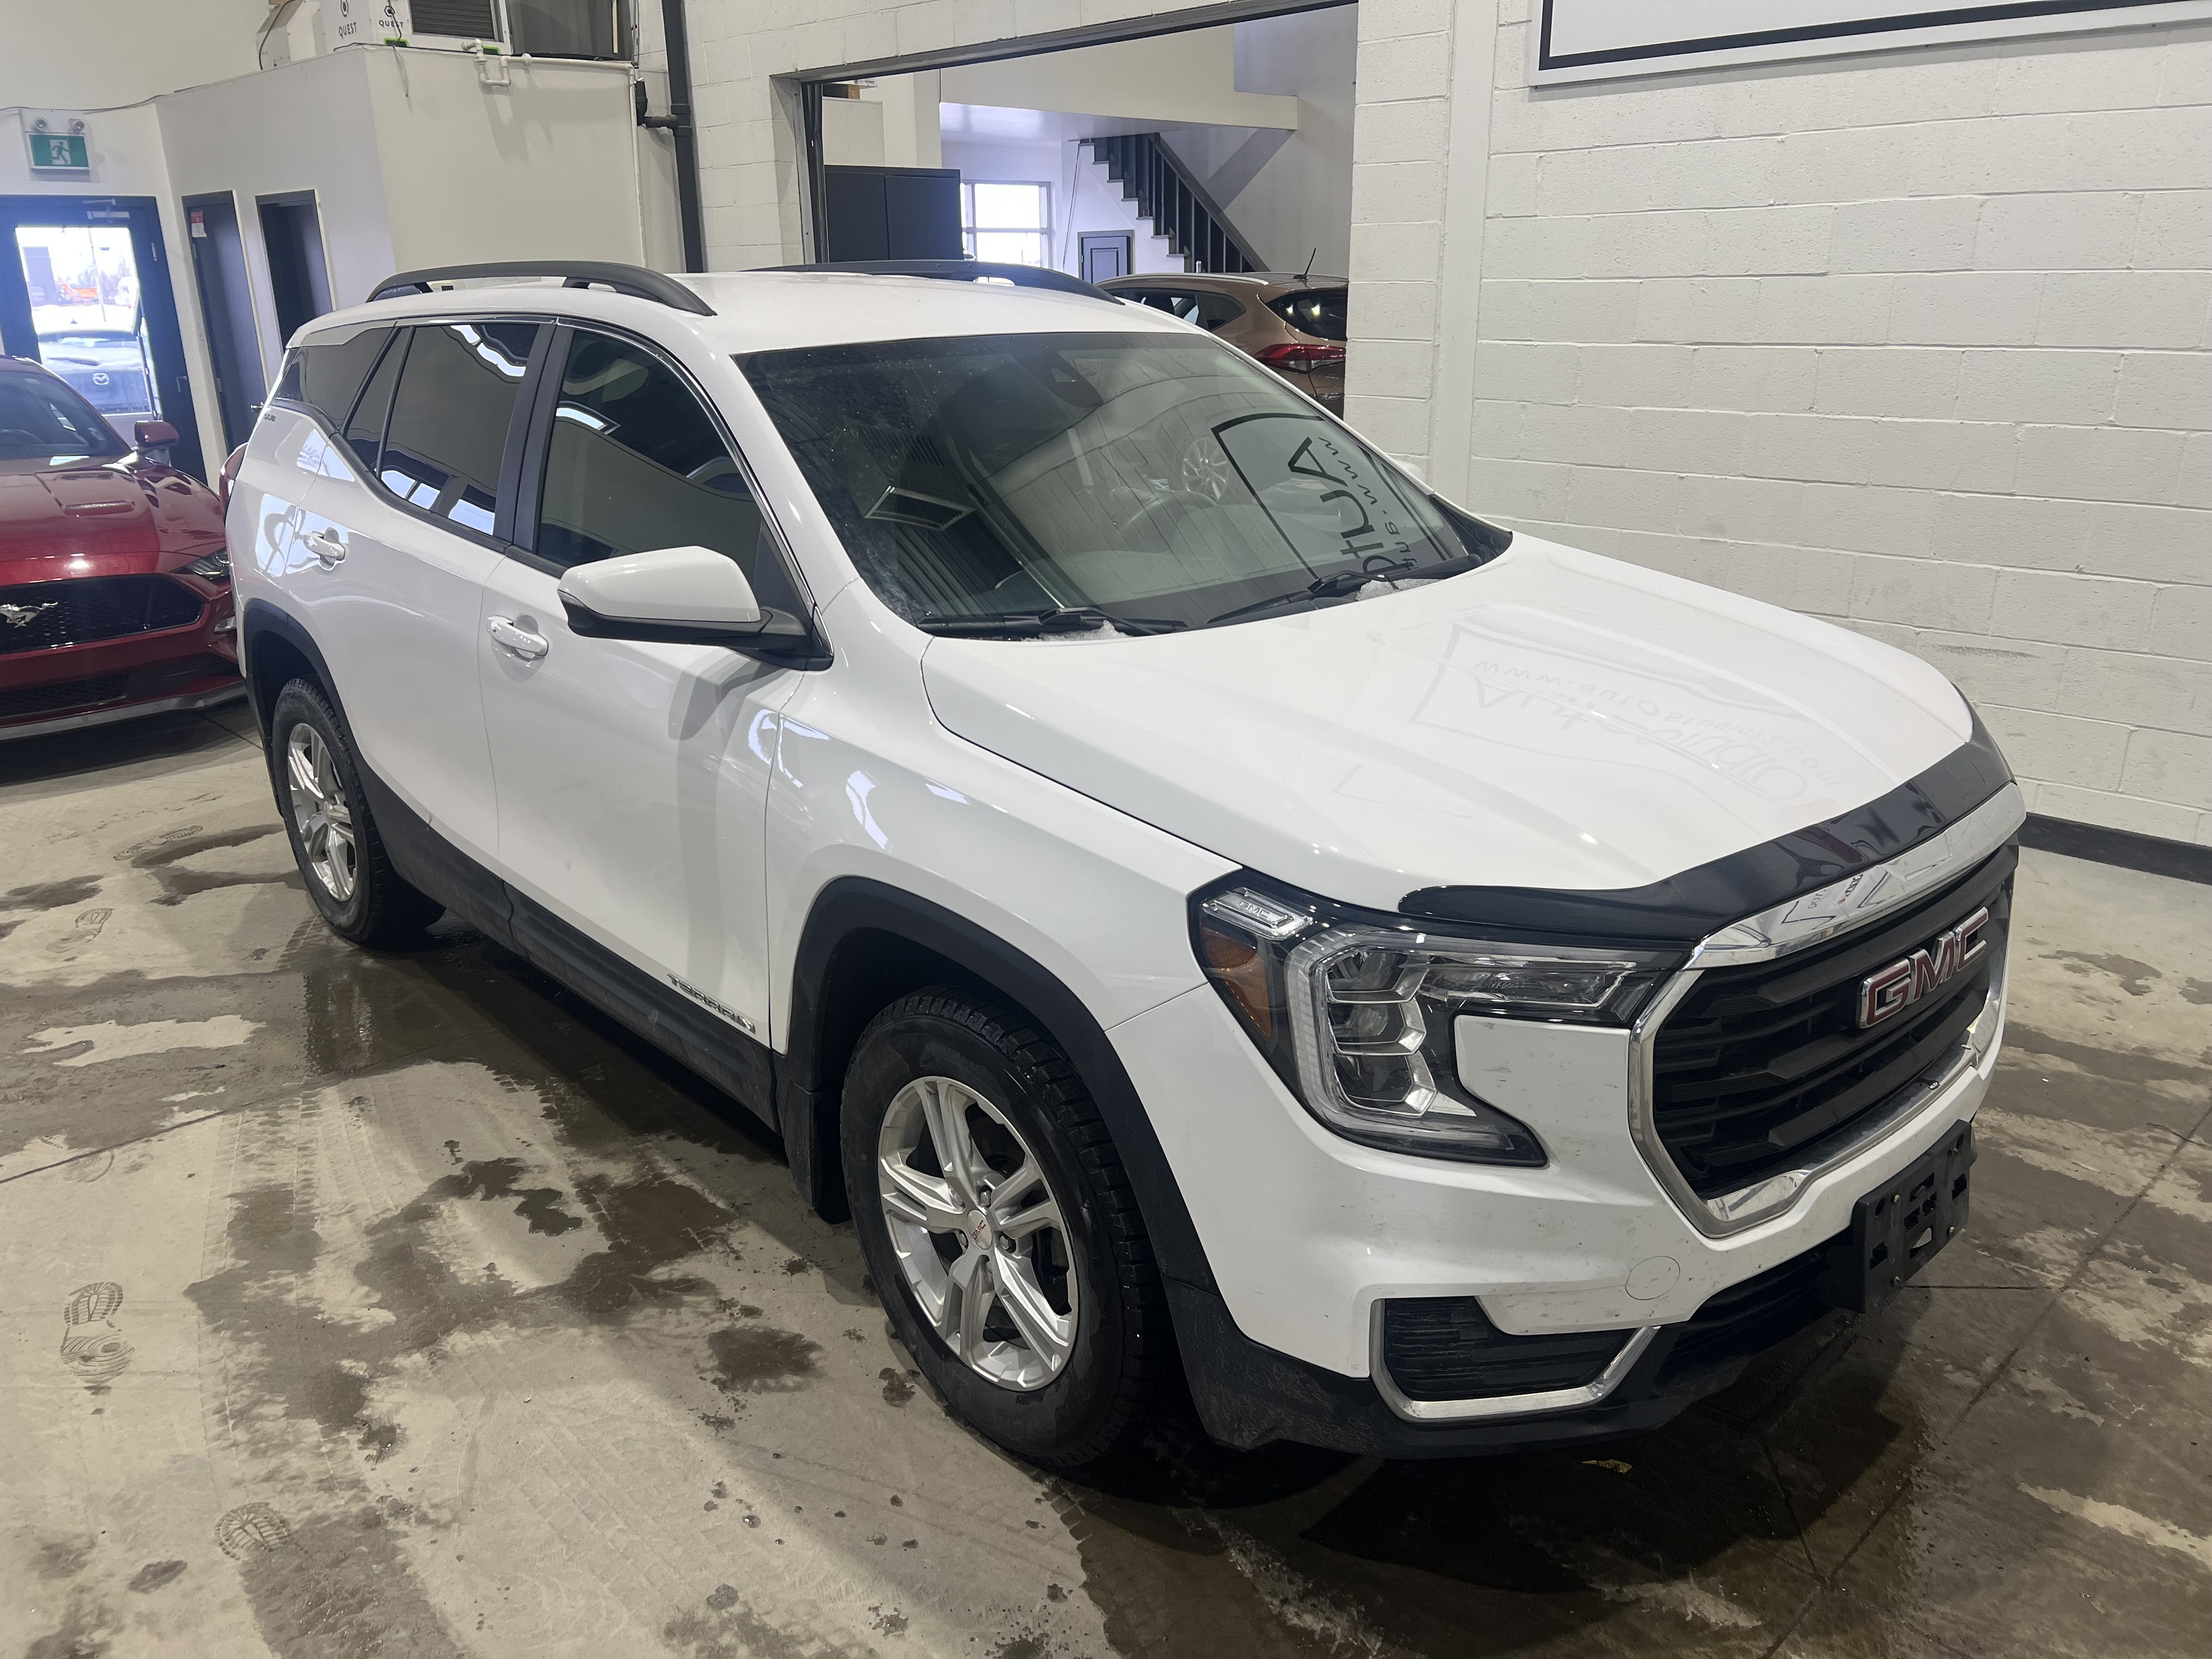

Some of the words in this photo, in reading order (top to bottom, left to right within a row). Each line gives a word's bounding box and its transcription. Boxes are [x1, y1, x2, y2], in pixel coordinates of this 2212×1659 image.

[338, 22, 357, 39] QUEST
[379, 20, 404, 28] QUEST
[1238, 901, 1272, 921] GMC
[1859, 906, 1989, 1029] GMC
[972, 1220, 986, 1240] GMC
